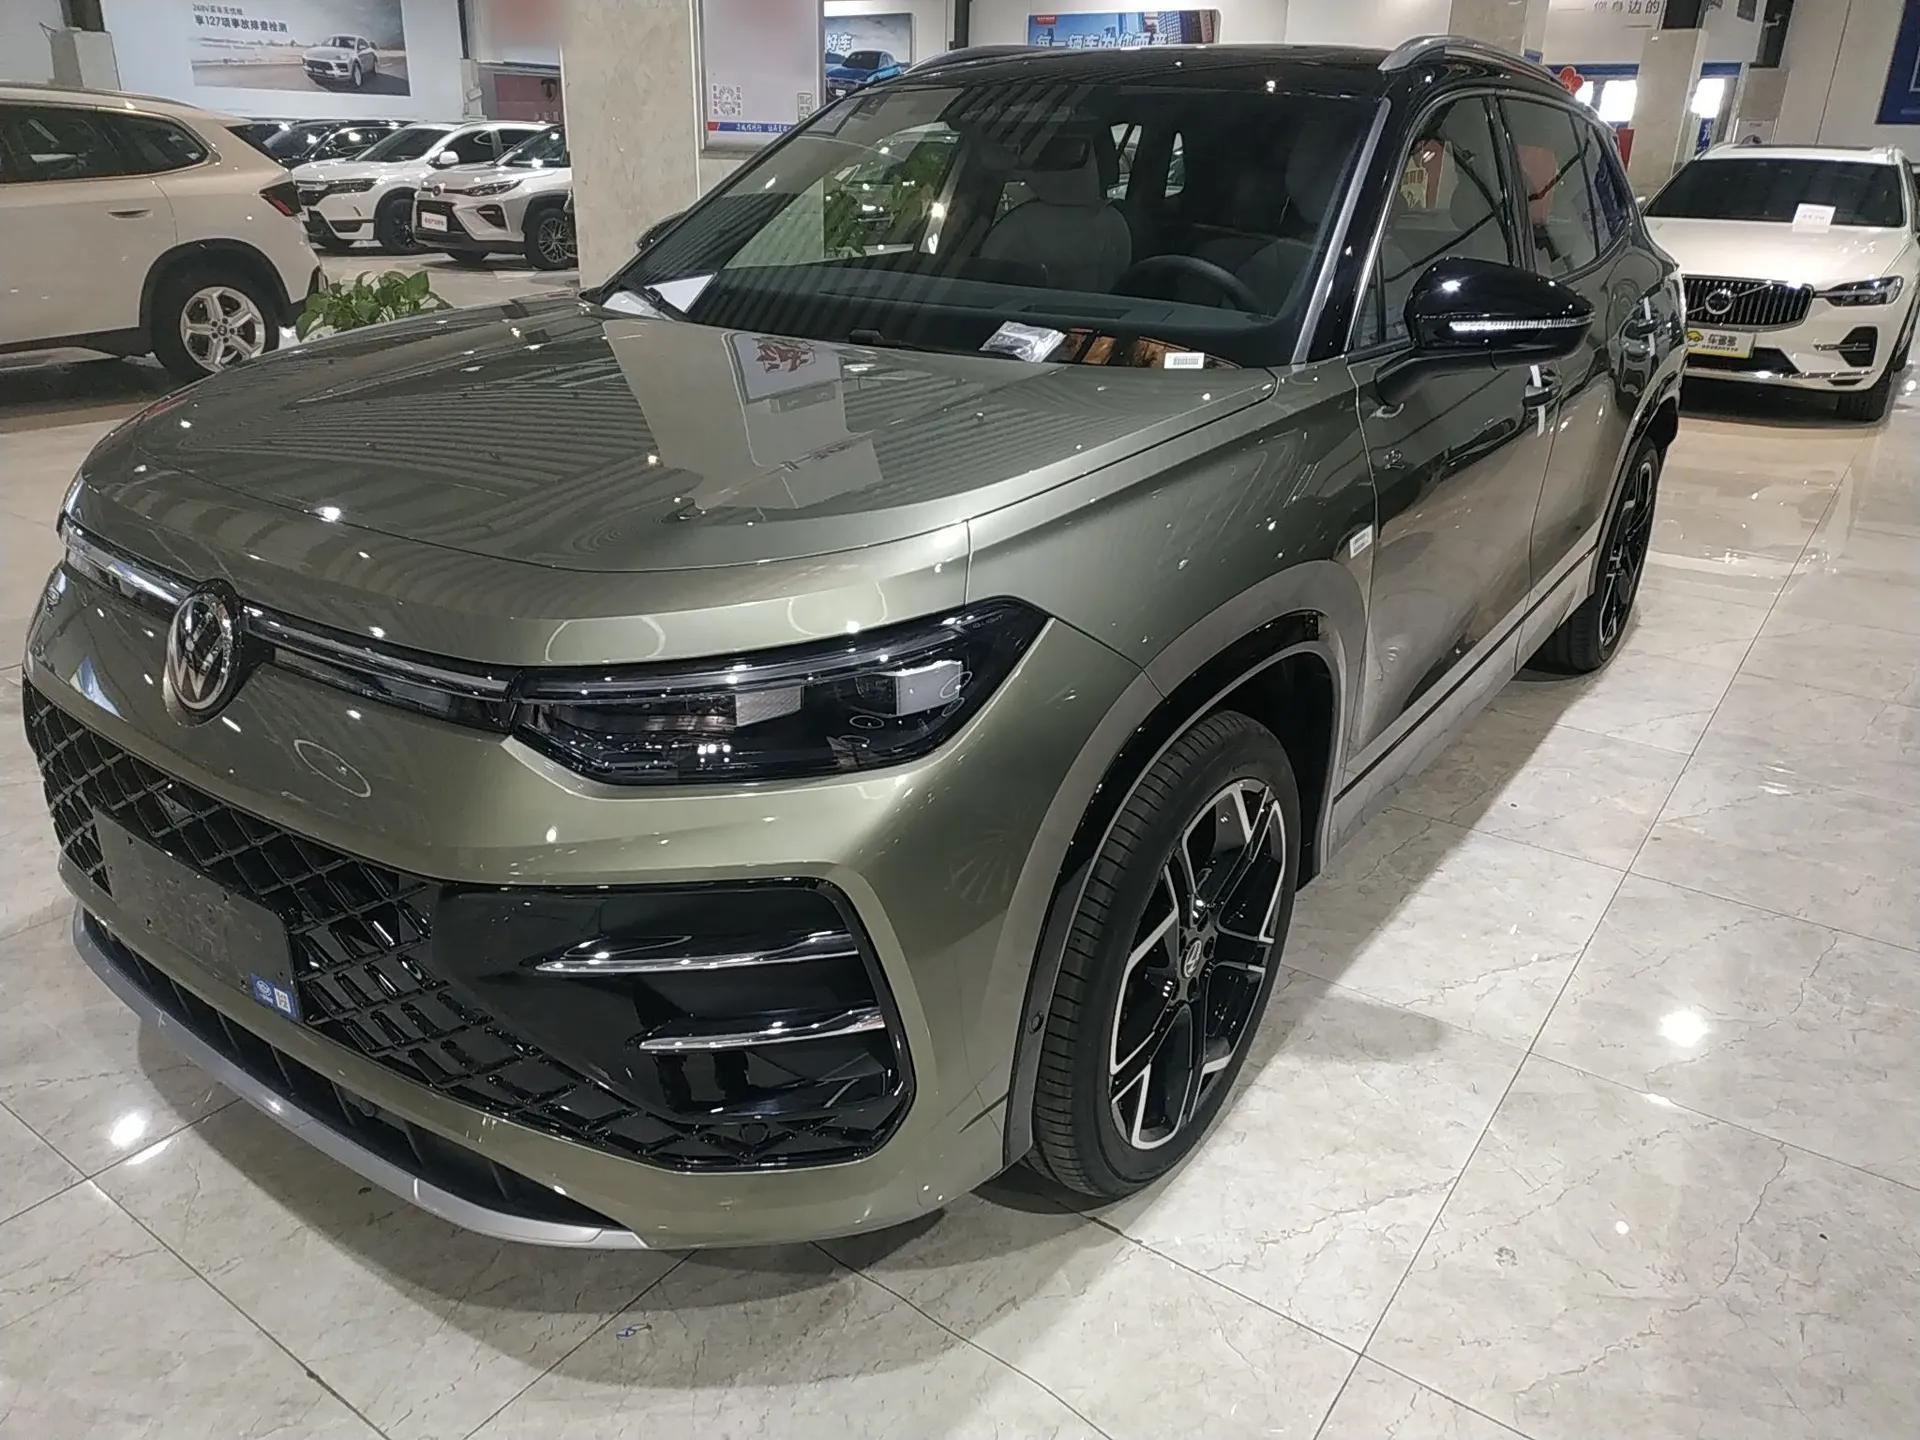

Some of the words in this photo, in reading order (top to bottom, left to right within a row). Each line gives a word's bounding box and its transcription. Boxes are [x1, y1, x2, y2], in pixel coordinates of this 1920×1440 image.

[826, 32, 853, 52] 好车
[1036, 32, 1168, 50] 每一辆车为你而来
